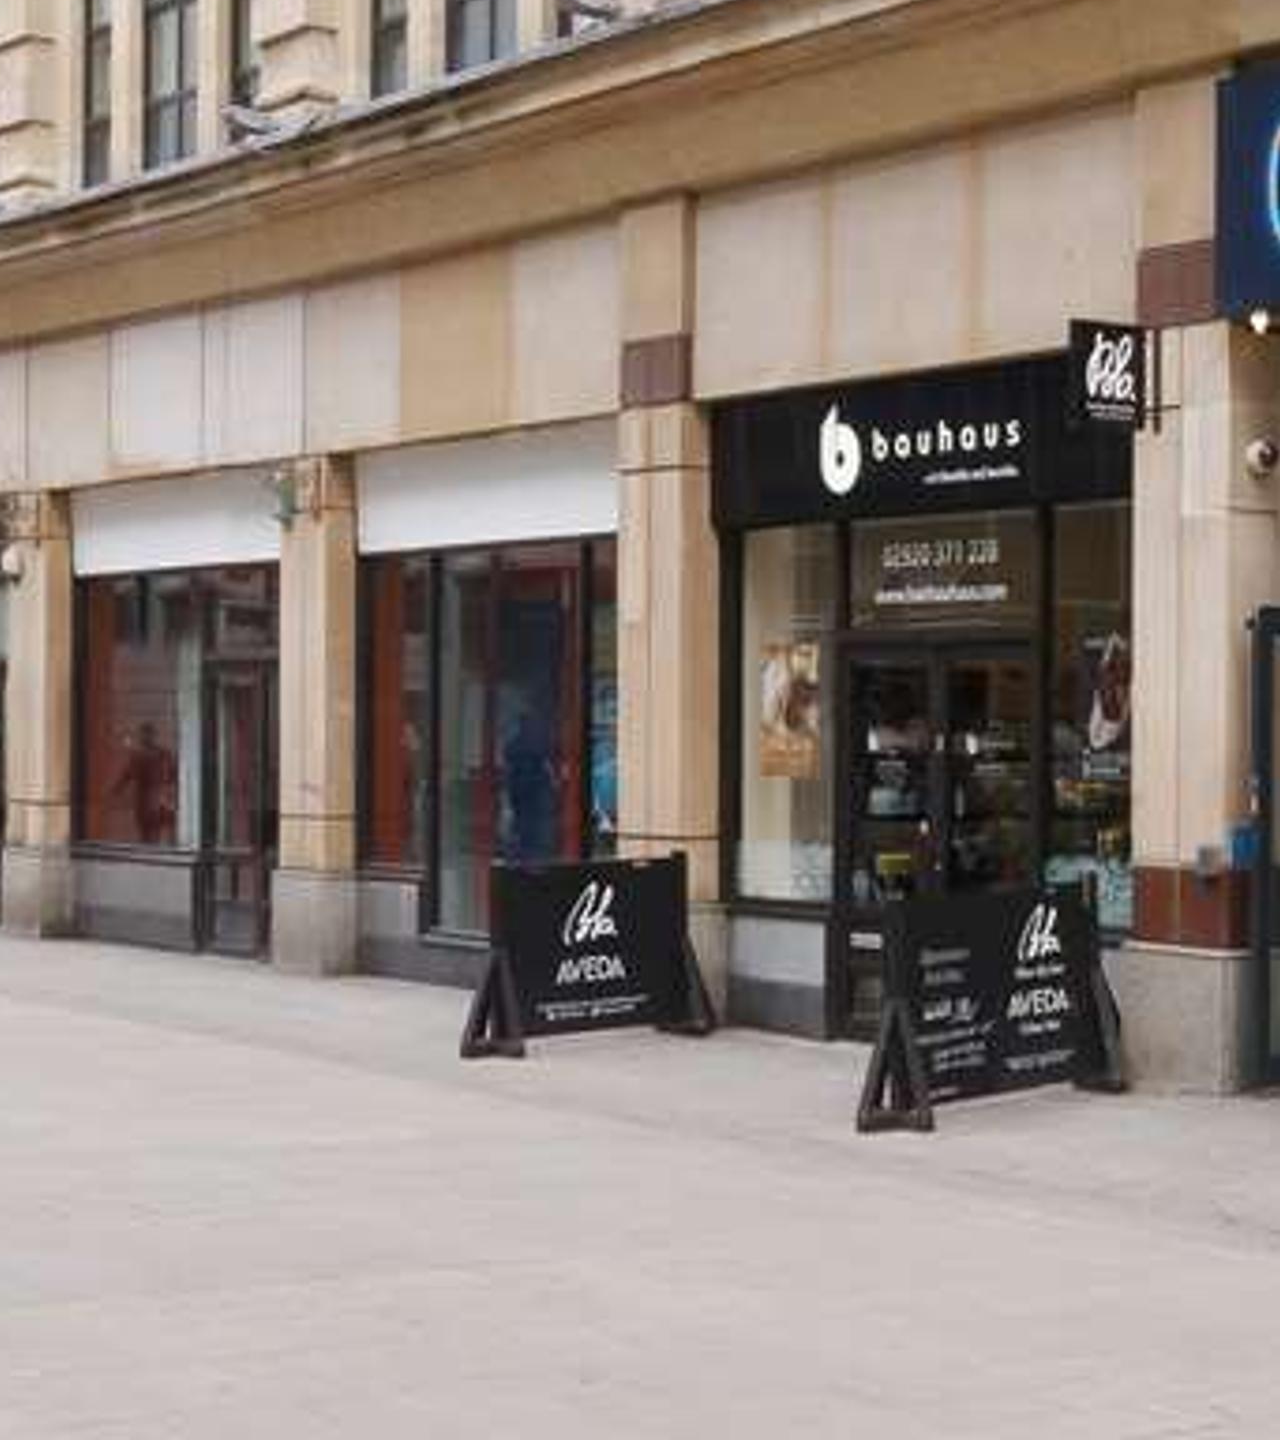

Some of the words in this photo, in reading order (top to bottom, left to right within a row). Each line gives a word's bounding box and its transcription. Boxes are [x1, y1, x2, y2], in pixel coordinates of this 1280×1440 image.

[872, 420, 1020, 461] bauhaus
[556, 956, 626, 985] AVEDA
[1007, 987, 1070, 1019] AVEDA
